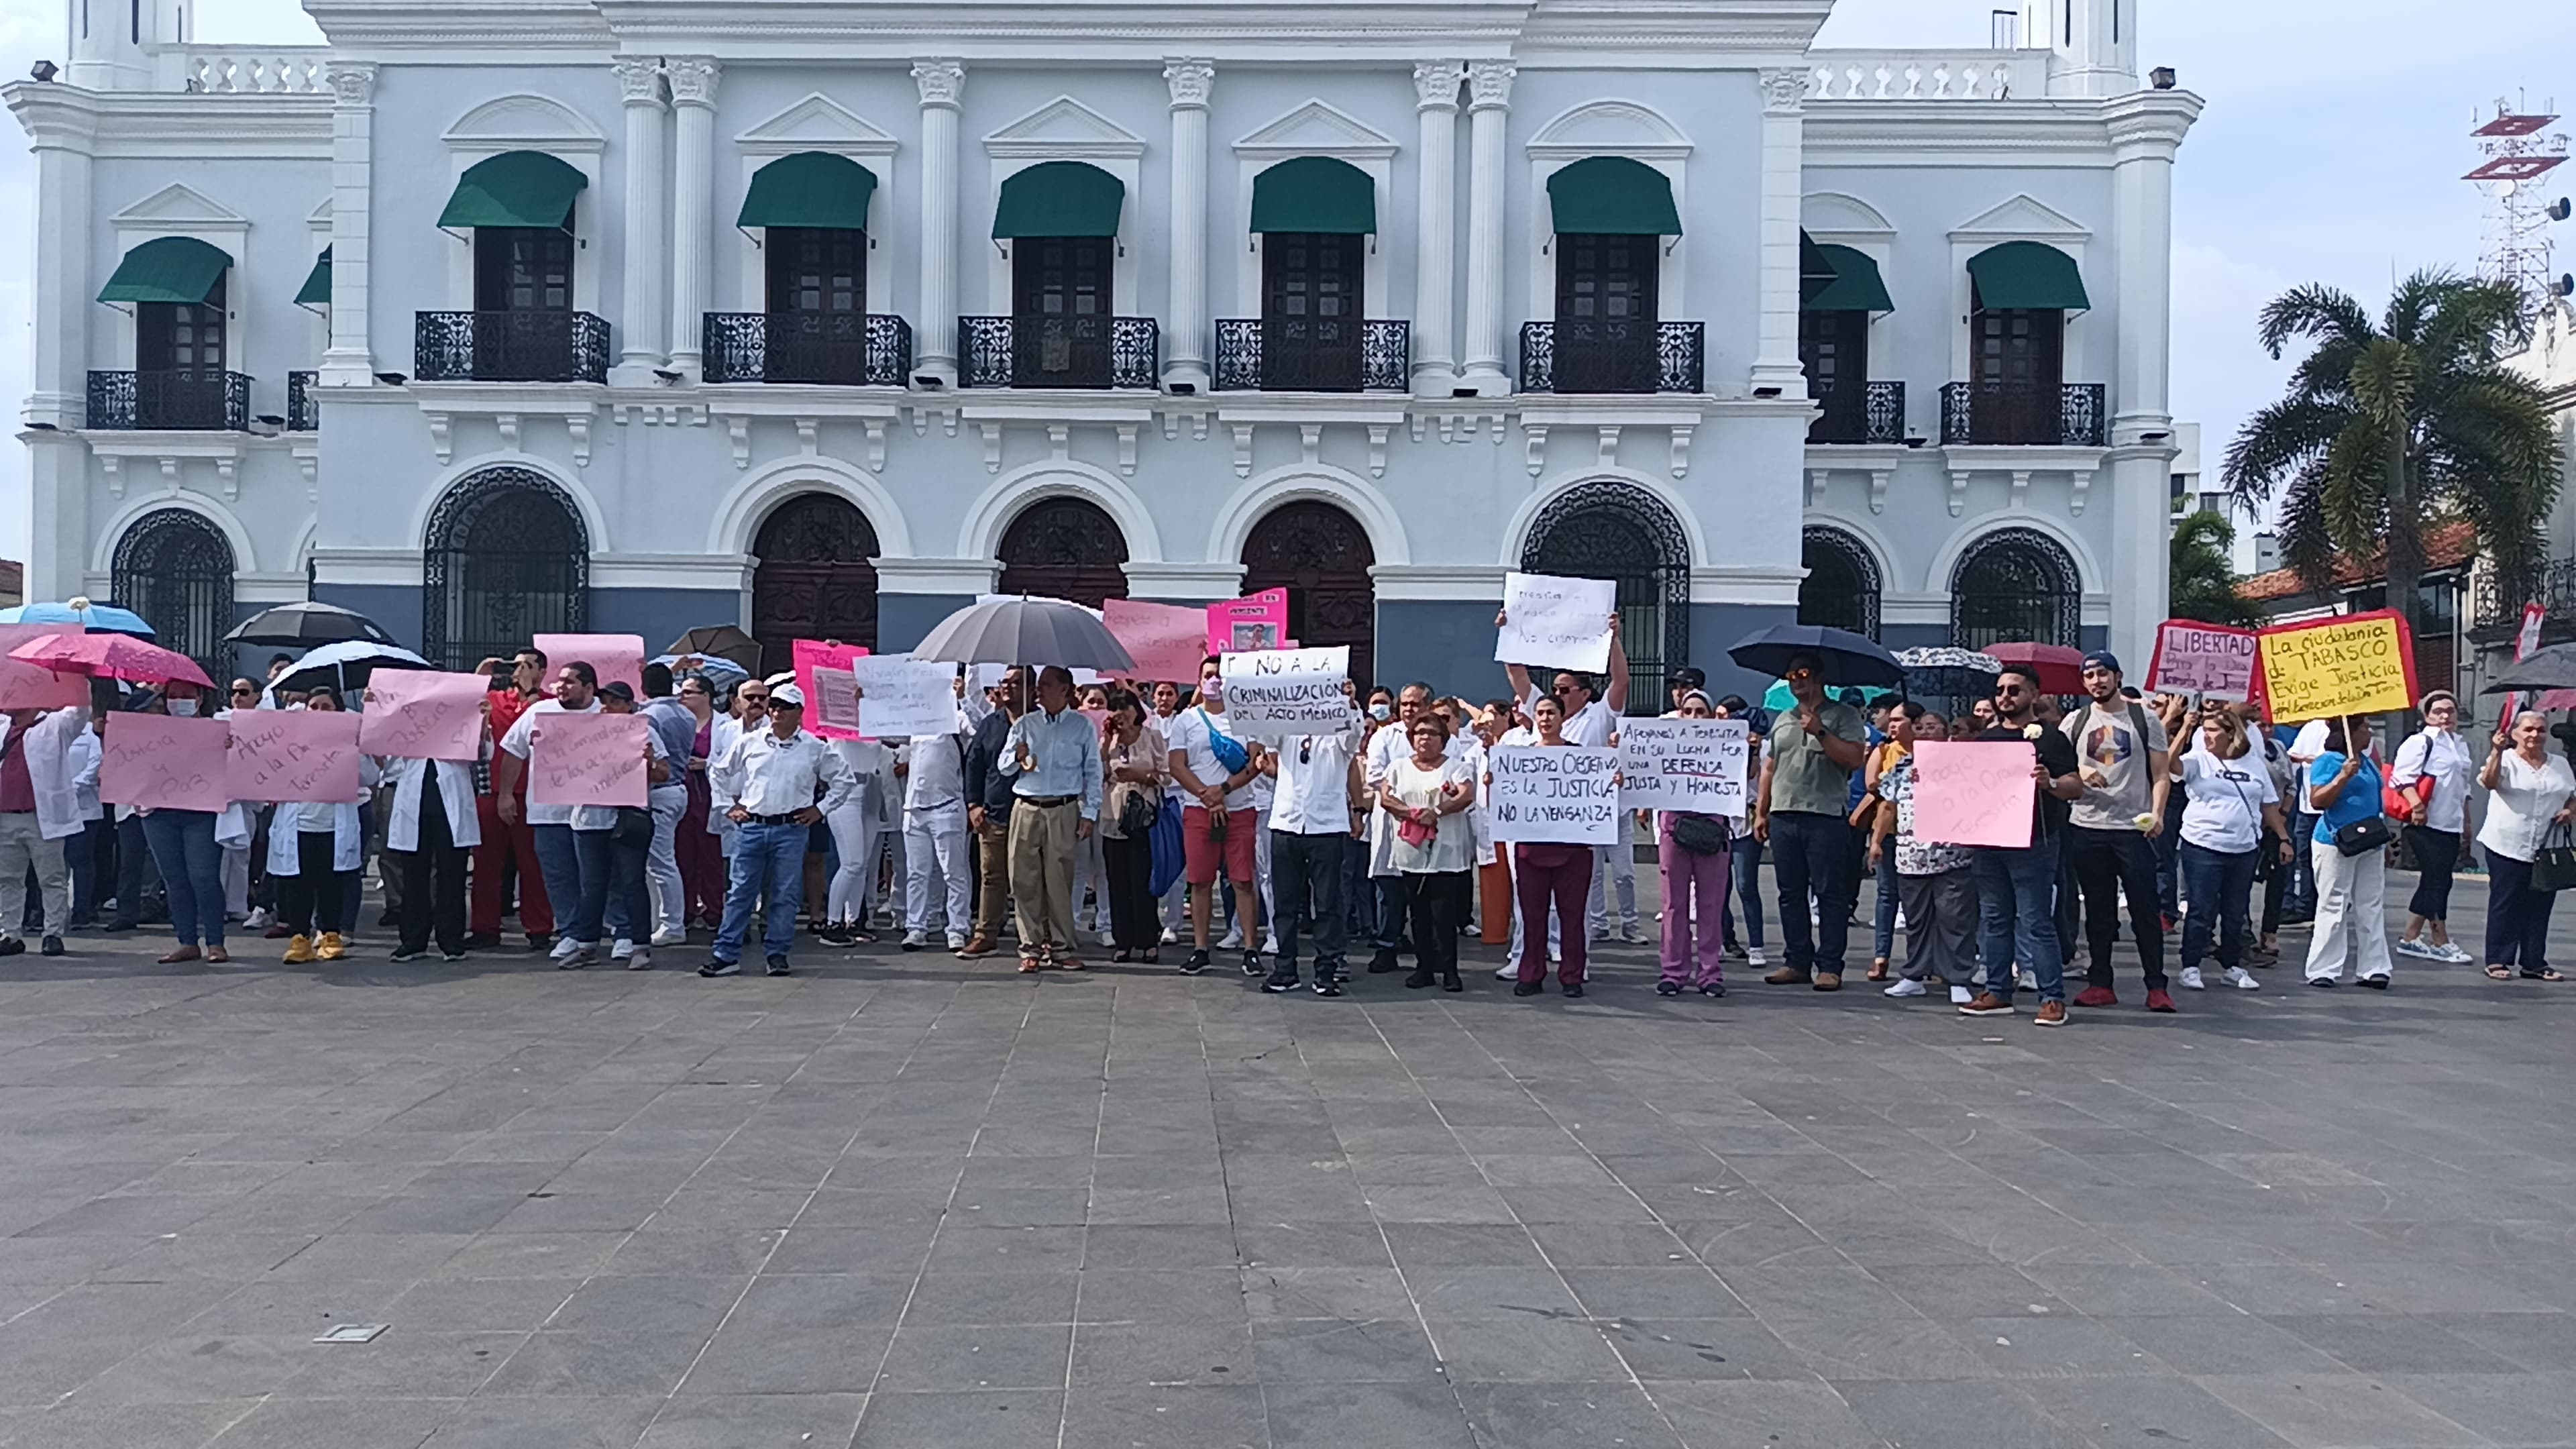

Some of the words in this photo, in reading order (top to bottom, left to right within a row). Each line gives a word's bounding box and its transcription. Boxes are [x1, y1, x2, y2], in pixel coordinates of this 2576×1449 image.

[2169, 629, 2254, 657] LIBERTAD
[2270, 636, 2293, 656] La
[1256, 655, 1281, 676] NO
[1291, 657, 1301, 672] A
[1312, 657, 1330, 672] LA
[2289, 640, 2387, 671] TABASCO
[2271, 678, 2319, 698] Exige
[2326, 660, 2400, 686] Justicia
[1234, 710, 1257, 720] DEL
[1265, 708, 1296, 720] ACTO
[1630, 744, 1646, 756] EN
[1651, 745, 1665, 757] SU
[1676, 743, 1710, 756] LUCHA
[254, 771, 268, 786] a
[265, 758, 285, 773] la
[1498, 754, 1558, 775] NUESTRO
[1628, 760, 1650, 770] UNA
[1501, 780, 1517, 796] ES
[1546, 777, 1615, 800] JUSTICIA
[1624, 775, 1662, 791] JUSTA
[1687, 777, 1741, 796] HONESTA
[1960, 786, 1980, 805] la
[1497, 802, 1517, 824] NO
[1525, 806, 1540, 823] LA
[1541, 804, 1613, 824] VENGANZA
